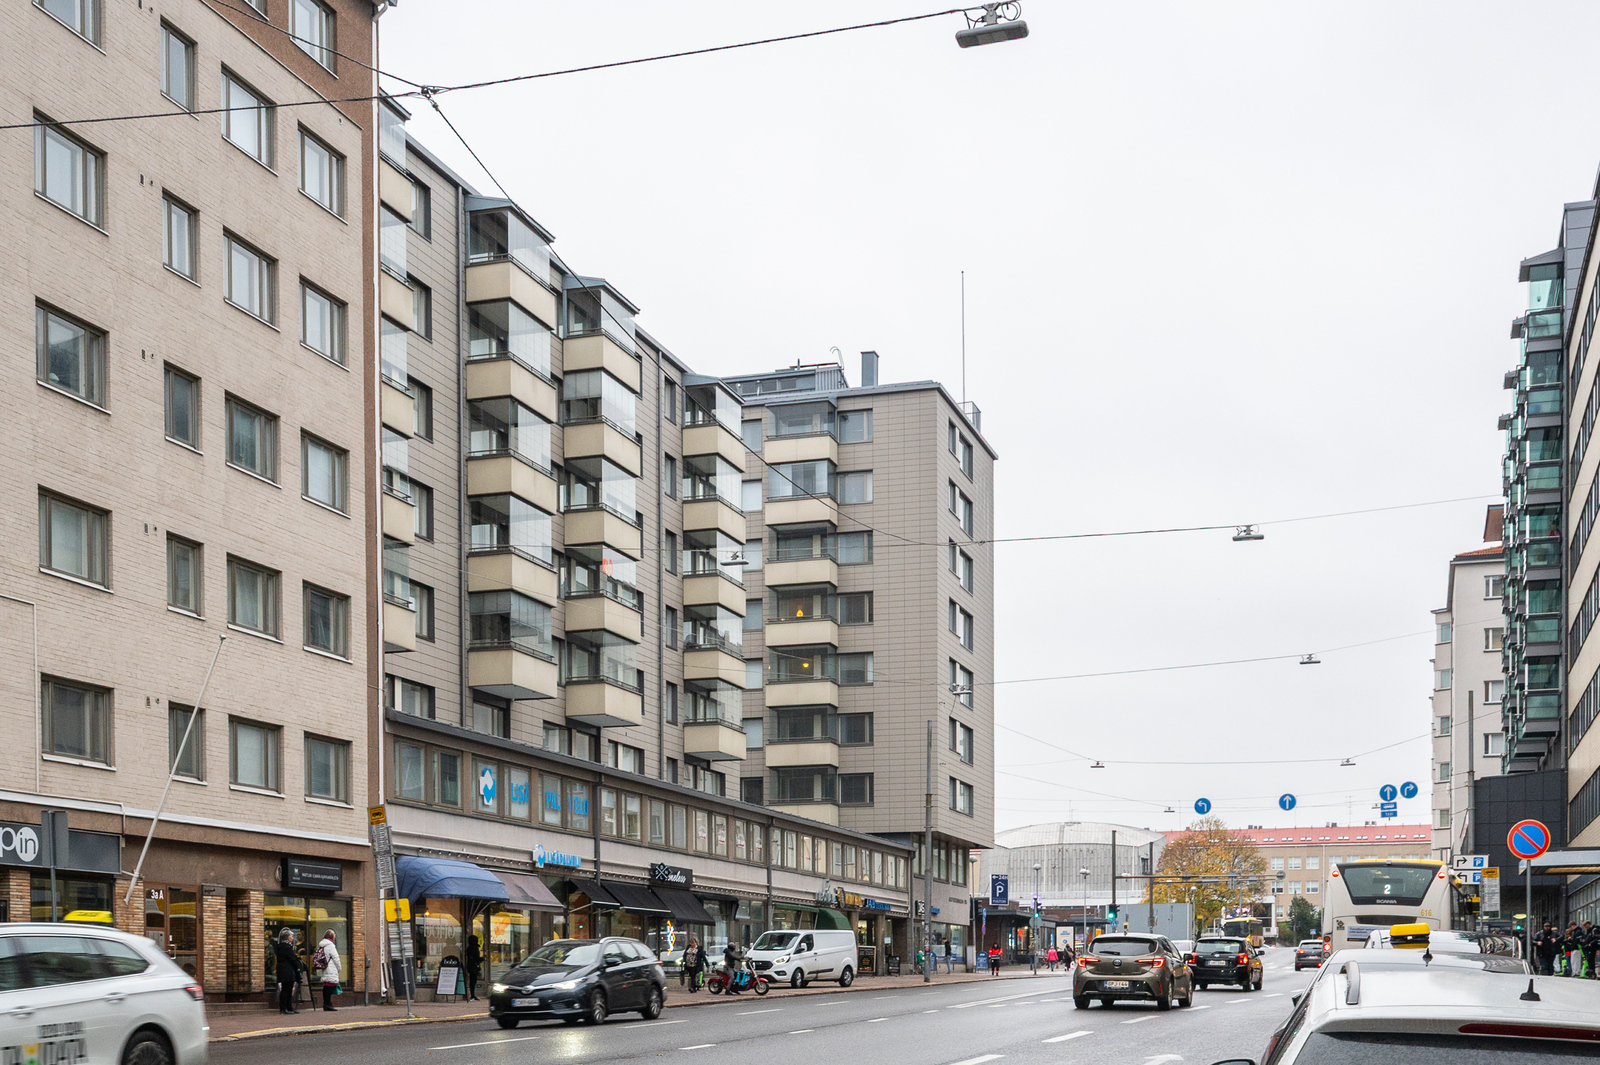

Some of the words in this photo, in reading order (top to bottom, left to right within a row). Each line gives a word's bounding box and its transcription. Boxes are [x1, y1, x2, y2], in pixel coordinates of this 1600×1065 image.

[511, 781, 529, 803] LISÄ
[996, 885, 1004, 897] P
[1384, 884, 1391, 894] 2
[158, 890, 164, 899] A
[1420, 908, 1432, 916] 616
